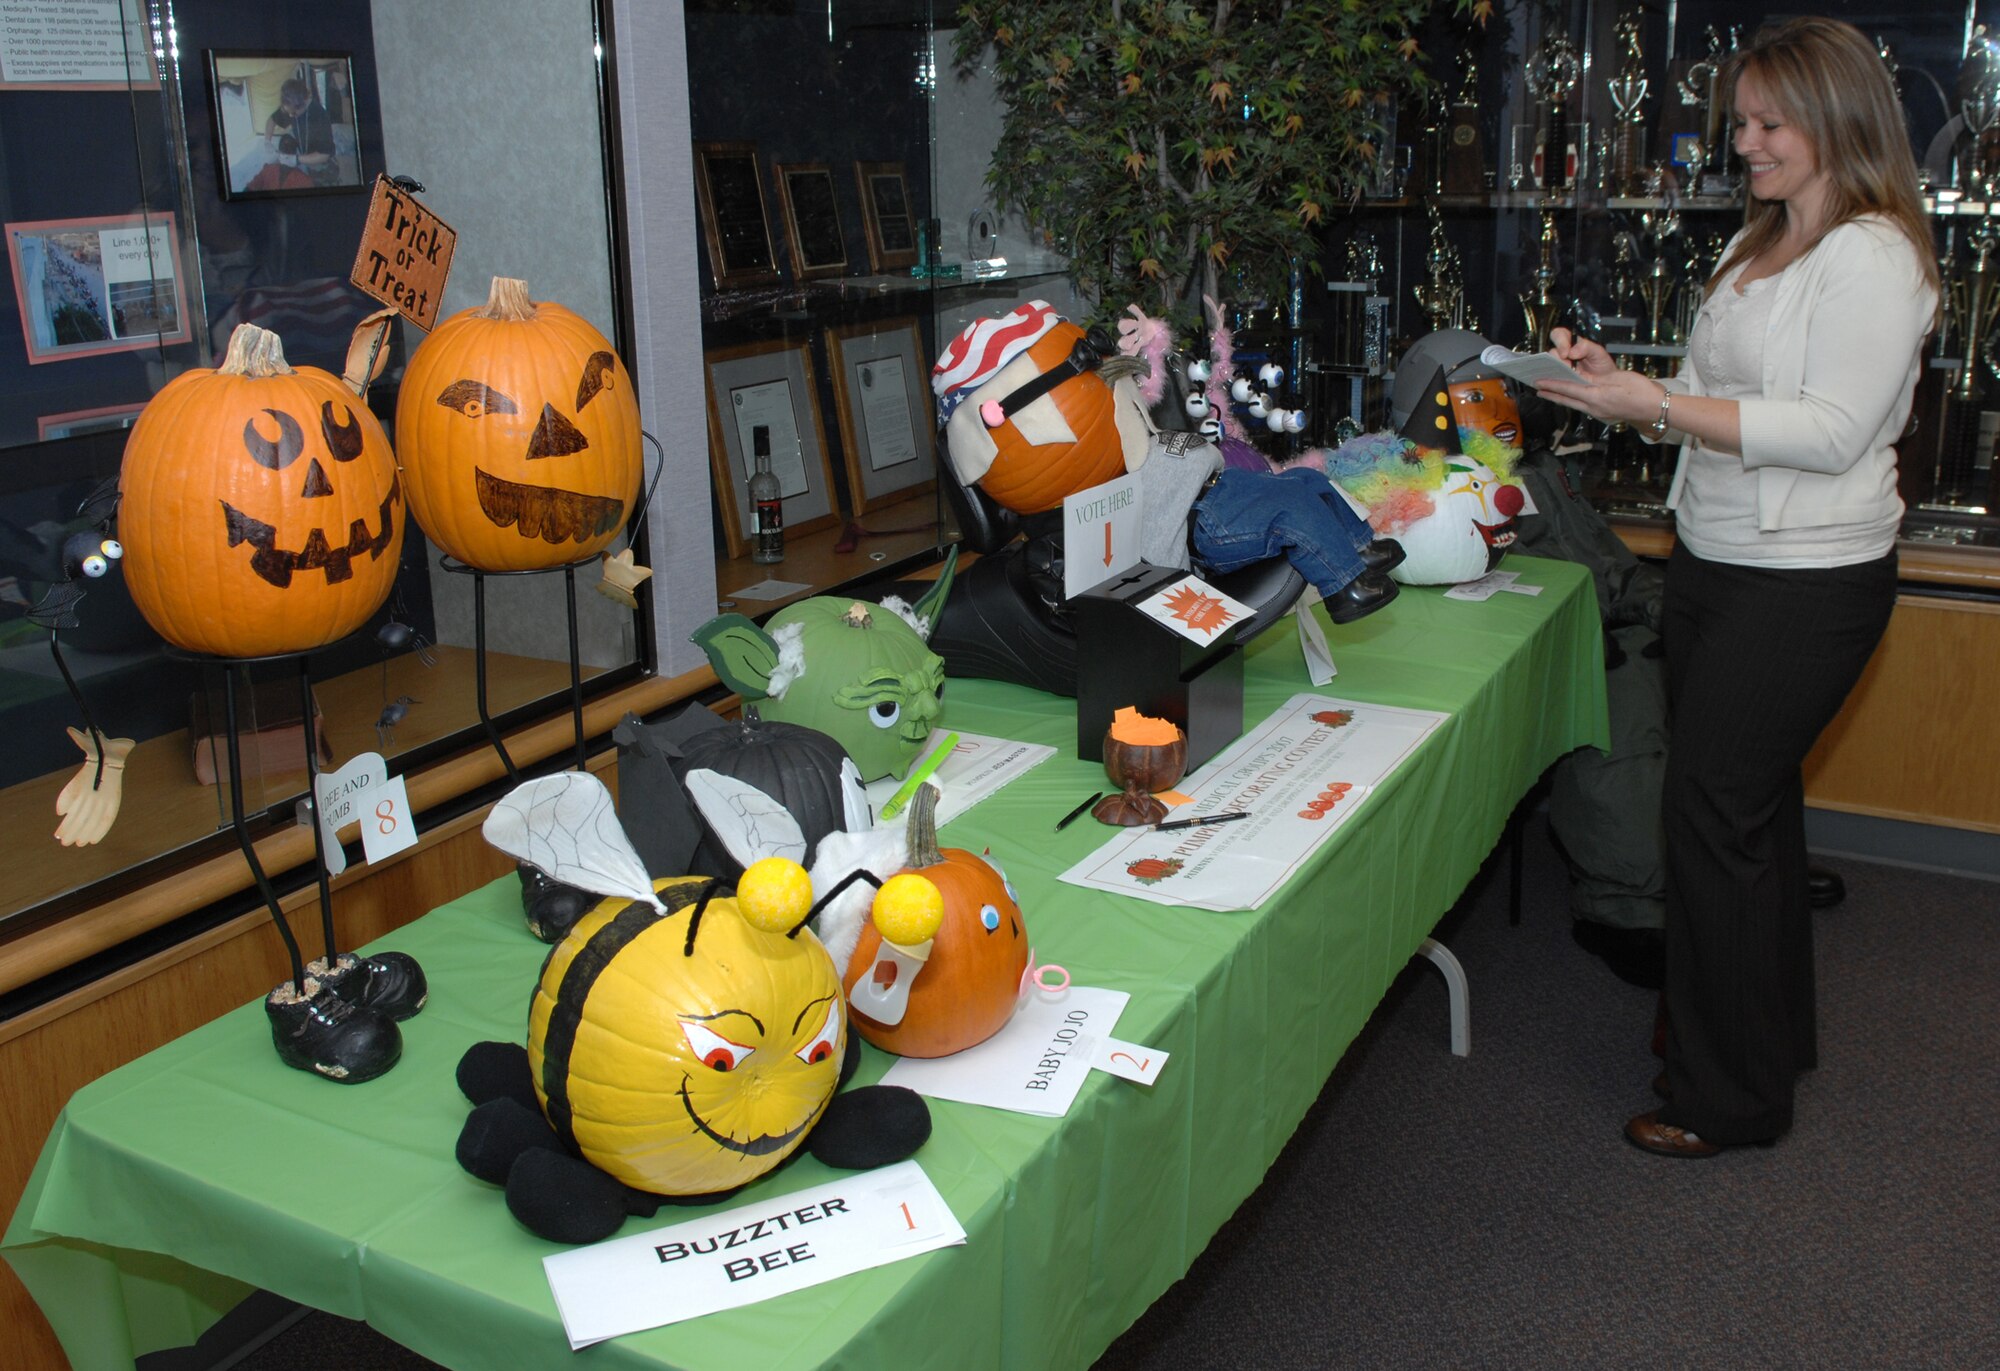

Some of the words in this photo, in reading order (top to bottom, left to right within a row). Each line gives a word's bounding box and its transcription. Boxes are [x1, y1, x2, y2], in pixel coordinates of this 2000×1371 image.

[3, 6, 32, 14] Medically
[6, 16, 26, 24] Dental
[56, 18, 79, 26] patients
[35, 60, 60, 68] supplies
[113, 238, 131, 248] Line
[385, 191, 442, 266] Trick
[119, 252, 141, 261] every
[396, 249, 414, 270] or
[369, 250, 428, 318] Treat
[1076, 498, 1106, 525] VOTE
[1109, 488, 1134, 513] HERE
[1284, 728, 1333, 762] CONTEST
[342, 774, 369, 797] AND
[1191, 779, 1242, 814] MEDICAL
[376, 799, 397, 834] 8
[1026, 1048, 1066, 1090] BABY
[1056, 1028, 1078, 1046] JO
[1068, 1010, 1088, 1028] JO
[1110, 1052, 1150, 1072] 2
[654, 1198, 851, 1263] BUZZTER
[898, 1202, 918, 1231] 1
[723, 1242, 816, 1282] BEE
